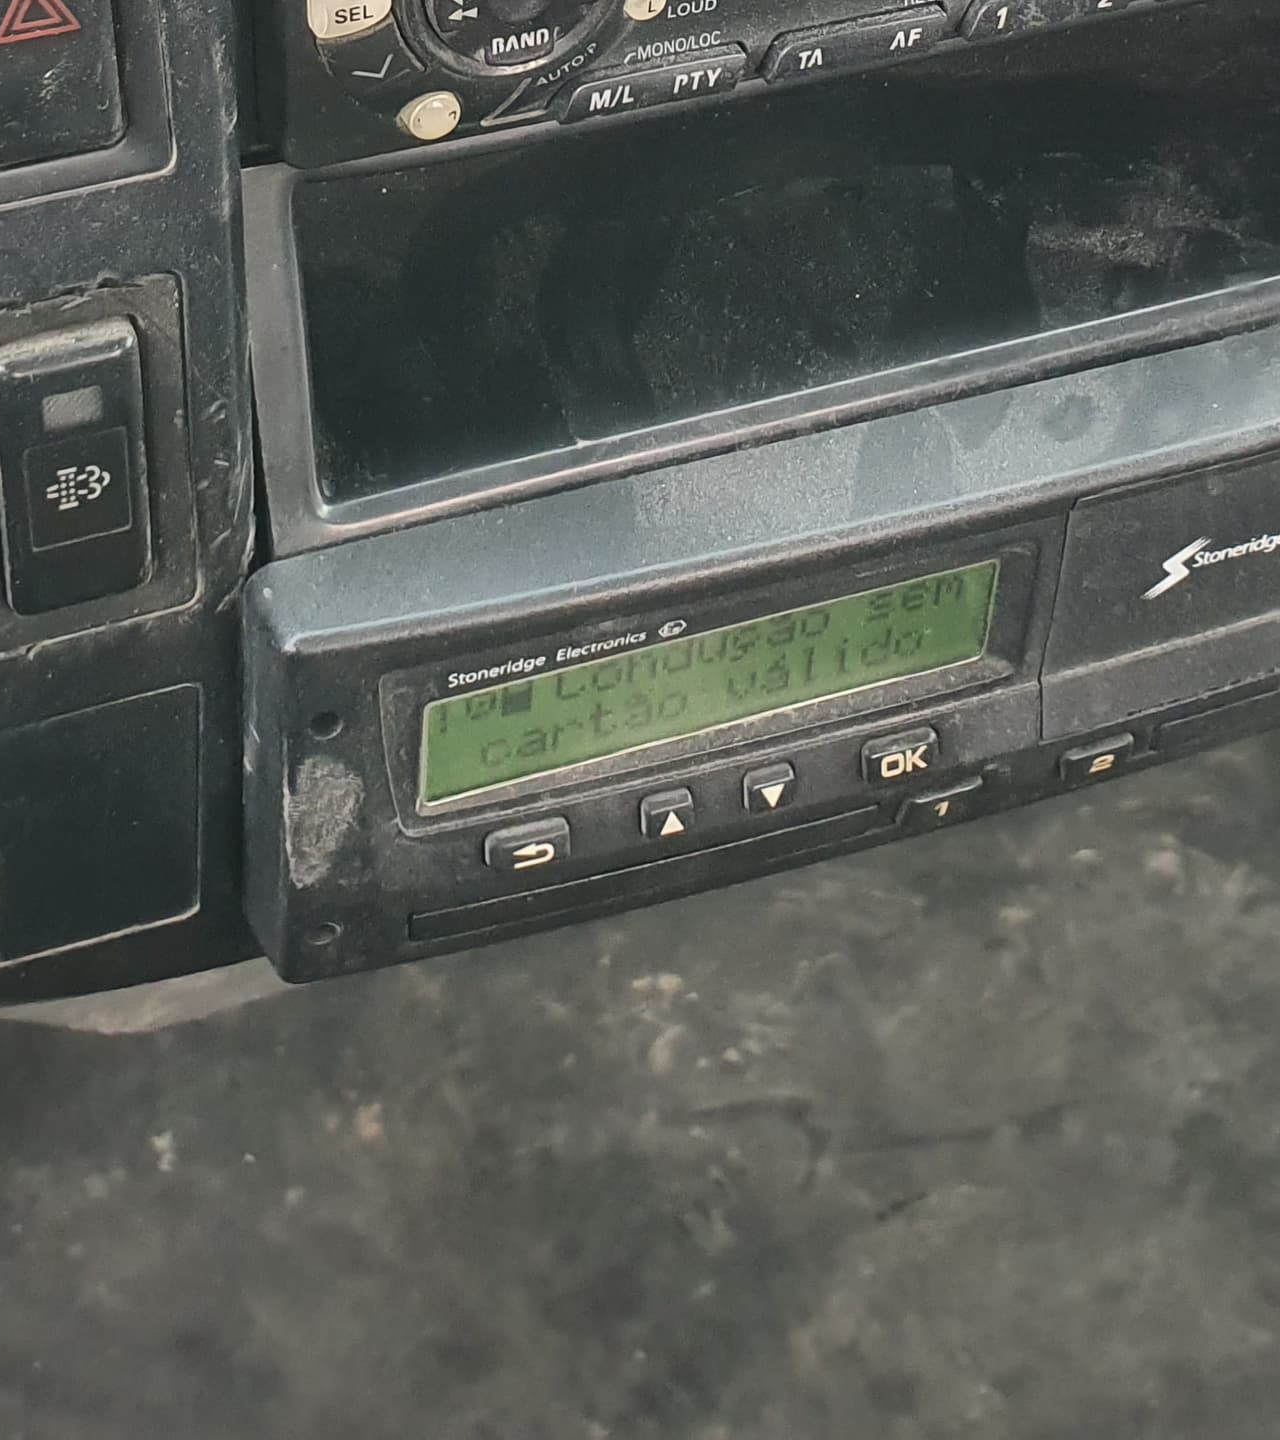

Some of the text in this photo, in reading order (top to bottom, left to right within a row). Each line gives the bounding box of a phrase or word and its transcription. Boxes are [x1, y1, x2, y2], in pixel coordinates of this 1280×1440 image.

[334, 4, 374, 25] SEL
[648, 0, 657, 13] L
[995, 6, 1009, 30] 1
[491, 28, 550, 56] BAND
[637, 30, 721, 60] MONO/LOC
[889, 28, 922, 51] AF
[798, 48, 823, 70] TA
[673, 67, 722, 94] PTY
[588, 84, 634, 112] M/L
[447, 630, 647, 689] Stoneridge Electronics
[880, 745, 928, 779] OK
[1088, 754, 1115, 774] 2
[934, 801, 949, 817] 1
